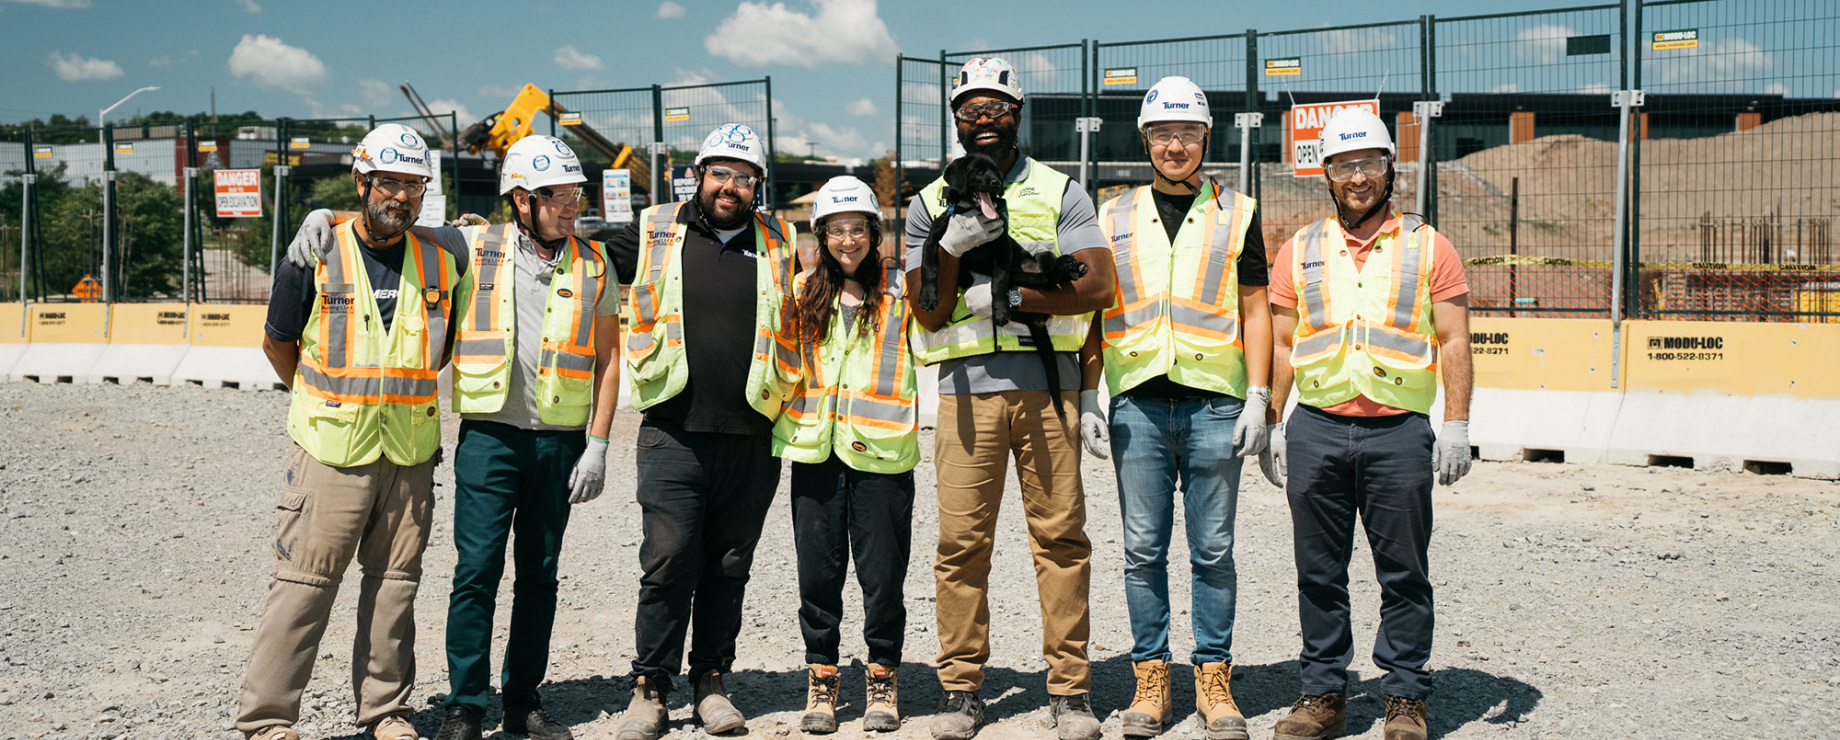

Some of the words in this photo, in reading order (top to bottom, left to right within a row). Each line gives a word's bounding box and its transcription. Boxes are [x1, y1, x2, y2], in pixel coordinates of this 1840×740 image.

[1163, 101, 1190, 109] Turner
[1339, 131, 1367, 141] Turner
[725, 141, 750, 152] Turner
[398, 153, 424, 165] Turner
[1296, 145, 1319, 164] OPEN
[562, 164, 580, 173] Turne
[216, 171, 258, 187] DANGER
[832, 196, 858, 204] Turner
[647, 230, 676, 240] Turner
[1110, 232, 1133, 243] Turner
[475, 247, 506, 259] Turner
[1301, 260, 1325, 270] Turner
[1472, 256, 1504, 265] CAUTION
[321, 294, 354, 305] Turner
[1664, 337, 1723, 349] MODU-LOC
[1647, 352, 1724, 360] 1-800-522-8371
